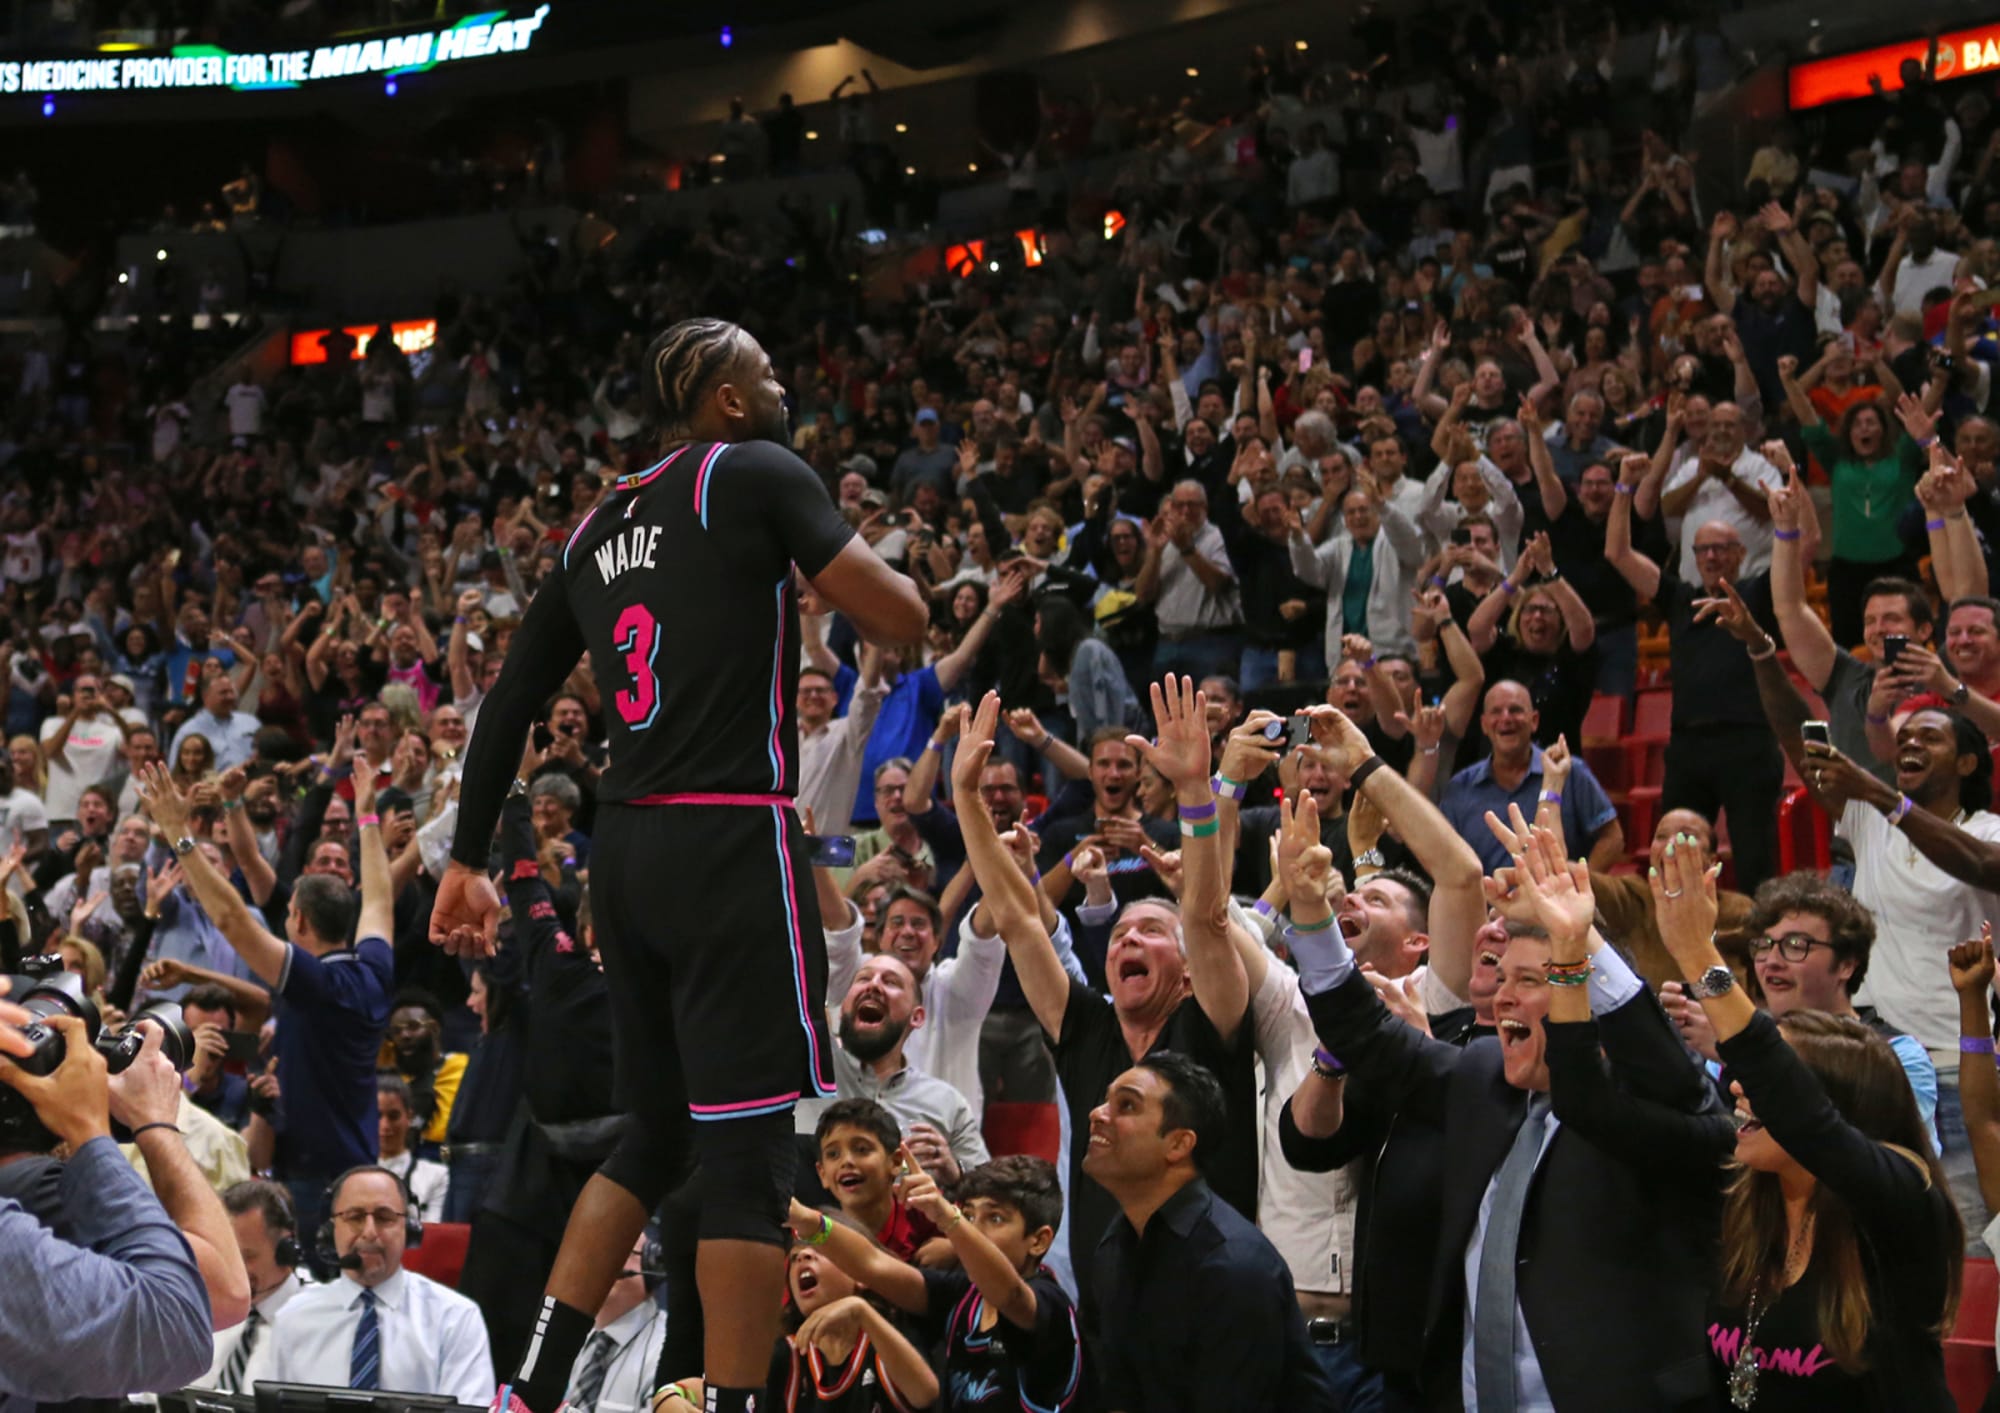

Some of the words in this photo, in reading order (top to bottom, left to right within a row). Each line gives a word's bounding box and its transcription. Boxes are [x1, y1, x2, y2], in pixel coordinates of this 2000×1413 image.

[22, 58, 121, 91] MEDICINE
[122, 55, 222, 89] PROVIDER
[225, 53, 267, 84] FOR
[269, 49, 309, 80] THE
[310, 32, 434, 79] MIAMI
[435, 3, 550, 61] HEAT
[1962, 37, 2000, 71] BA
[594, 525, 663, 585] WADE
[613, 603, 661, 731] 3
